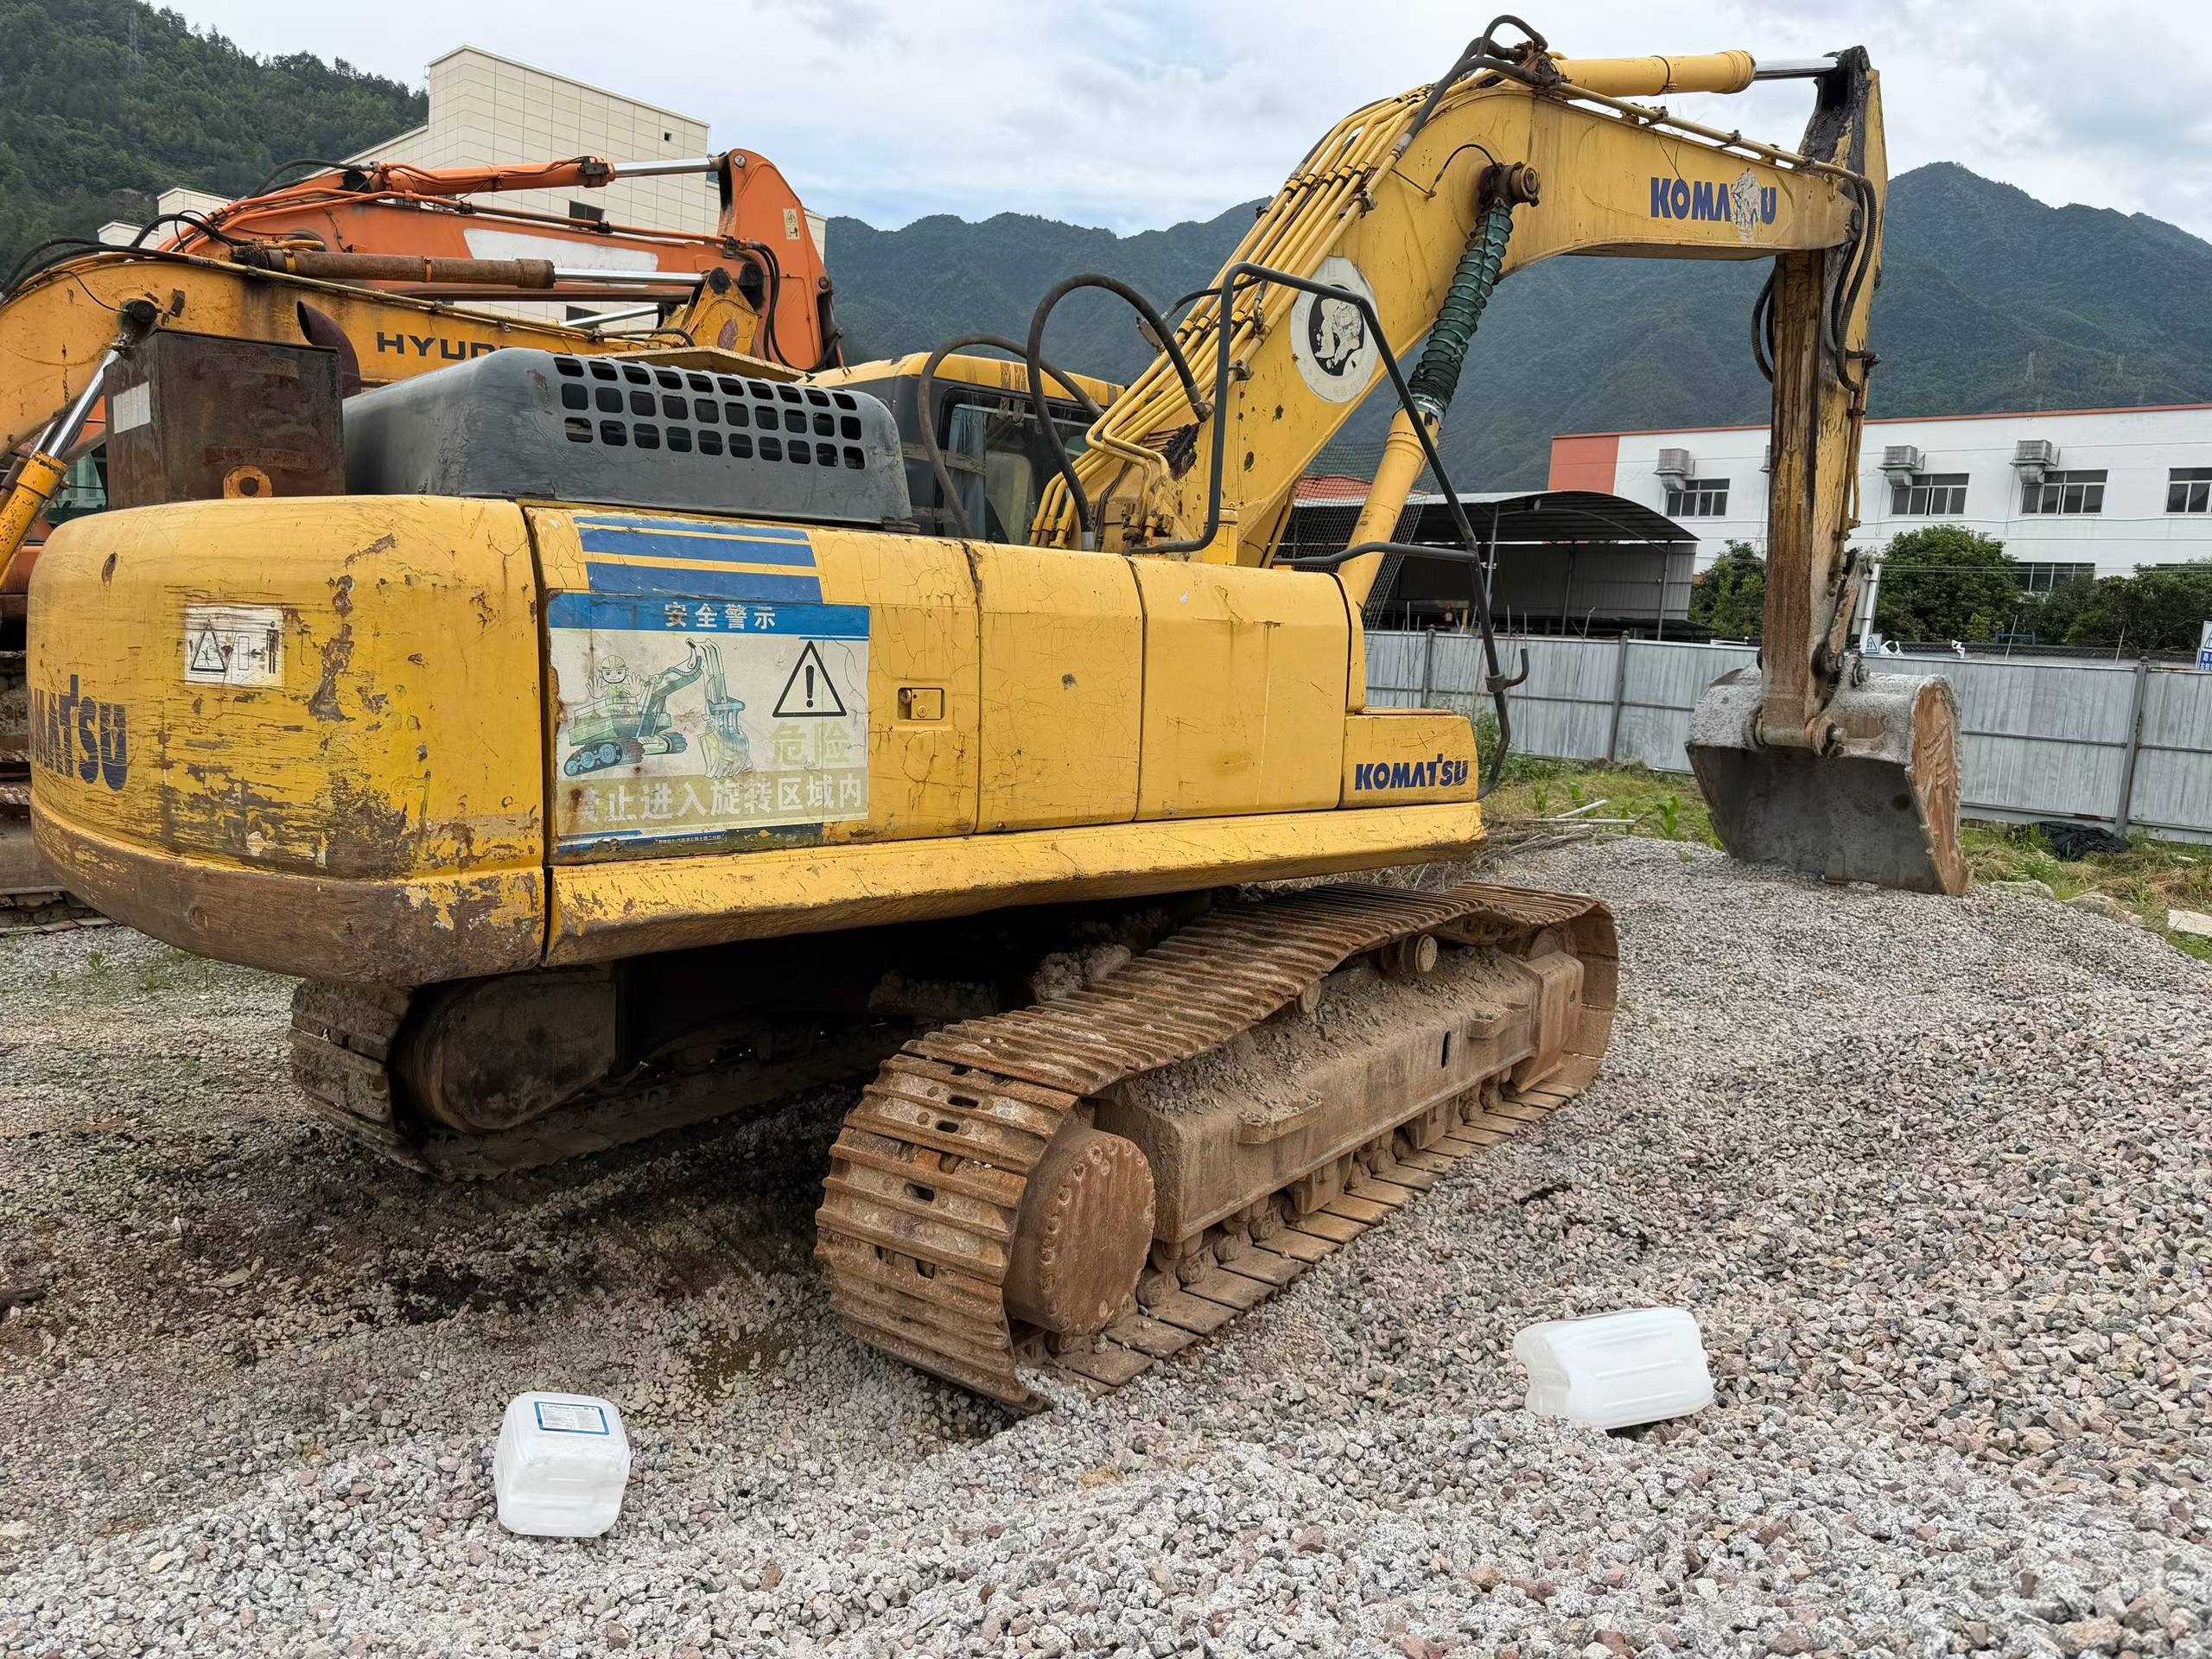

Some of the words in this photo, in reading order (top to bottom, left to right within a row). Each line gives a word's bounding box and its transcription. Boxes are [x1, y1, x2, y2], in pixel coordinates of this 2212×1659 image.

[1650, 176, 1777, 226] KOMAU
[664, 601, 778, 631] 安全警示
[771, 721, 851, 764] 危险
[1354, 753, 1469, 791] KOMATSU
